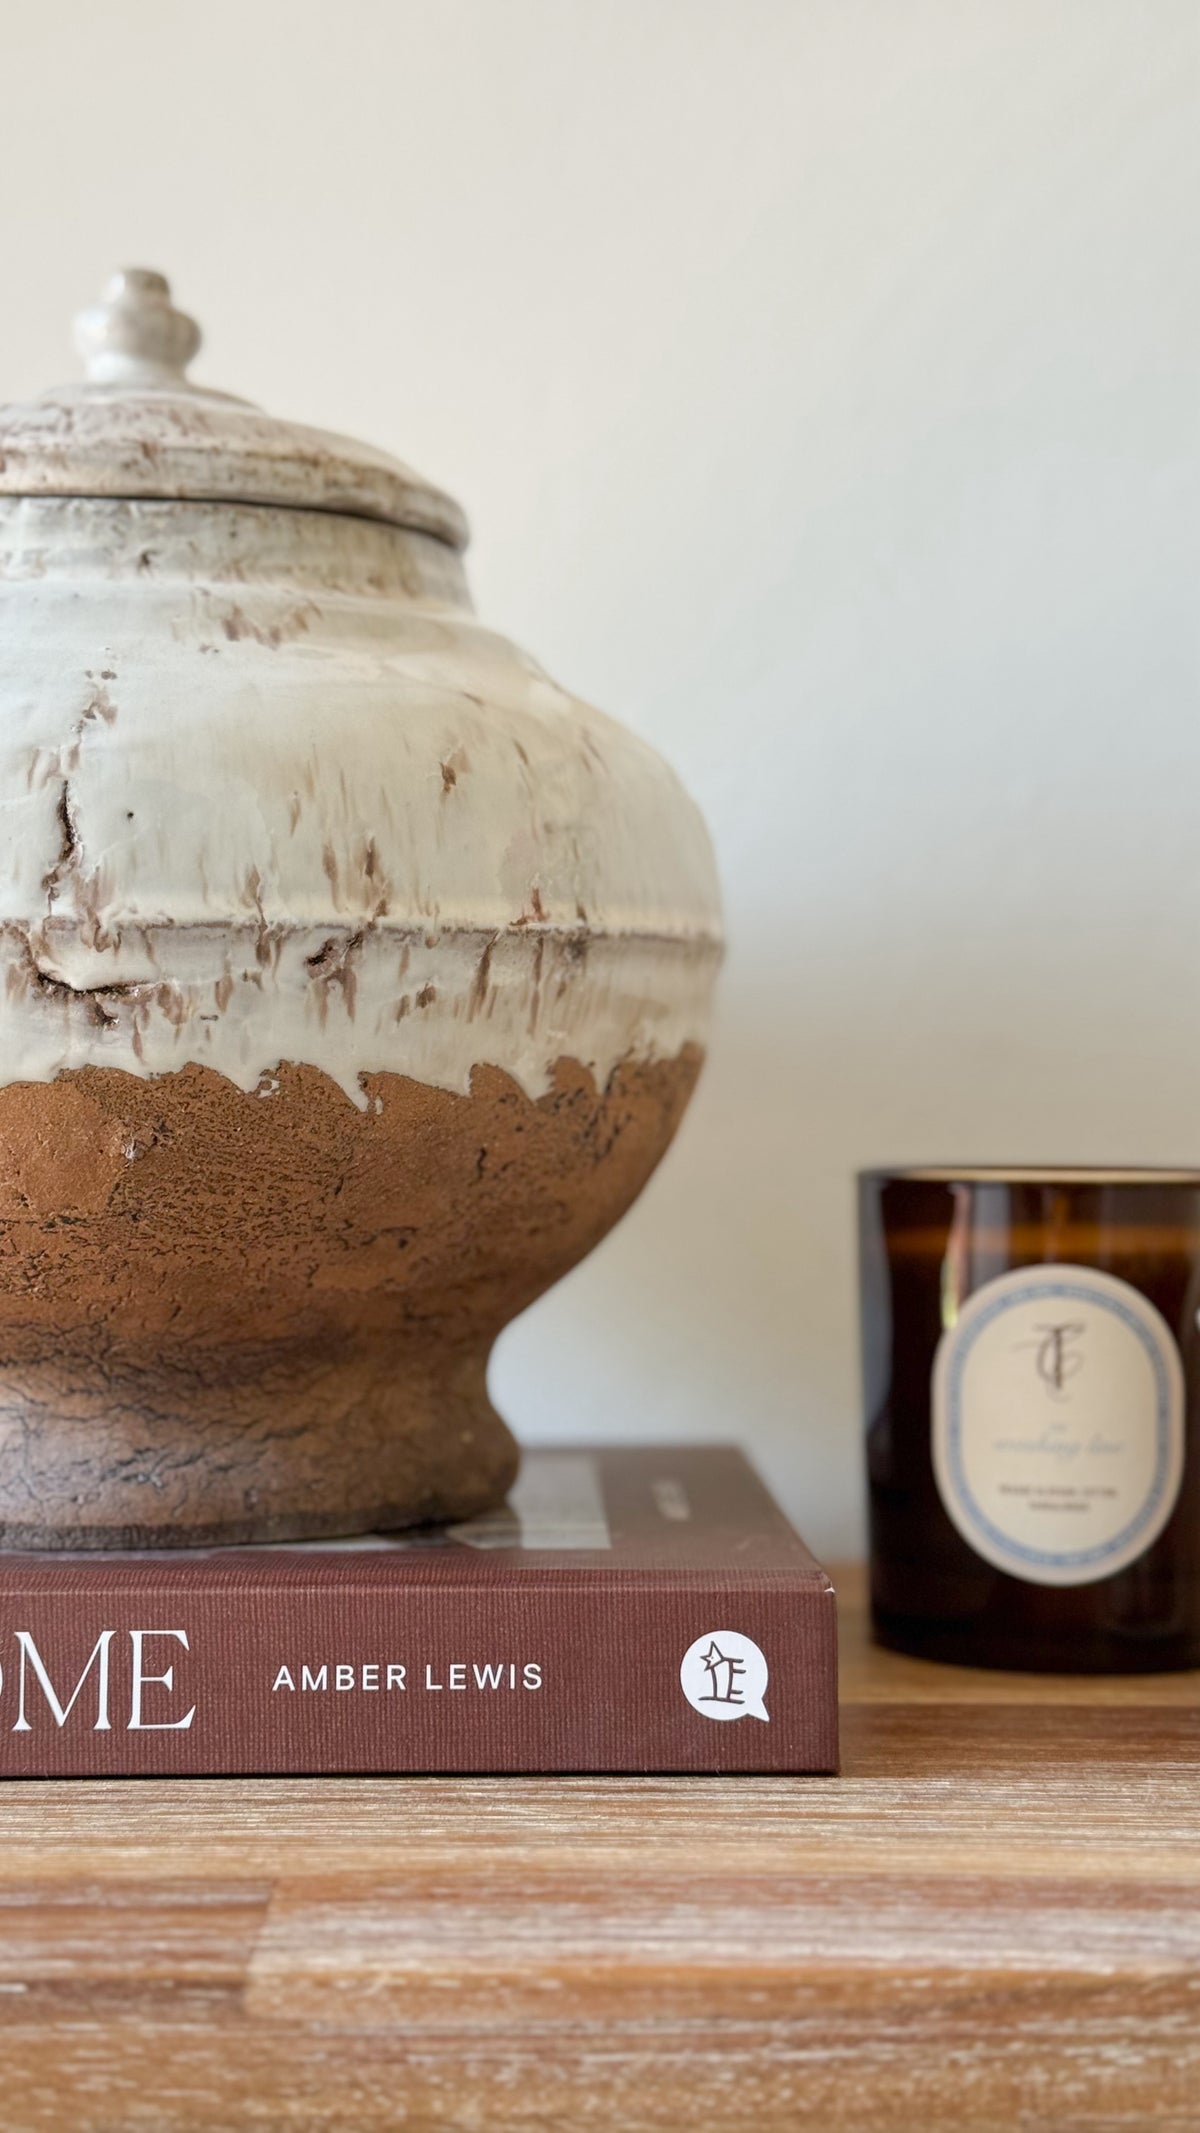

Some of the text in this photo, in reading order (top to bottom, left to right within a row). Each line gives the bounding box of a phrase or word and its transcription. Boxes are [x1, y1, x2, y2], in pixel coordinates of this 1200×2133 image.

[0, 1629, 196, 1731] ME
[271, 1663, 543, 1692] AMBER LEWIS
